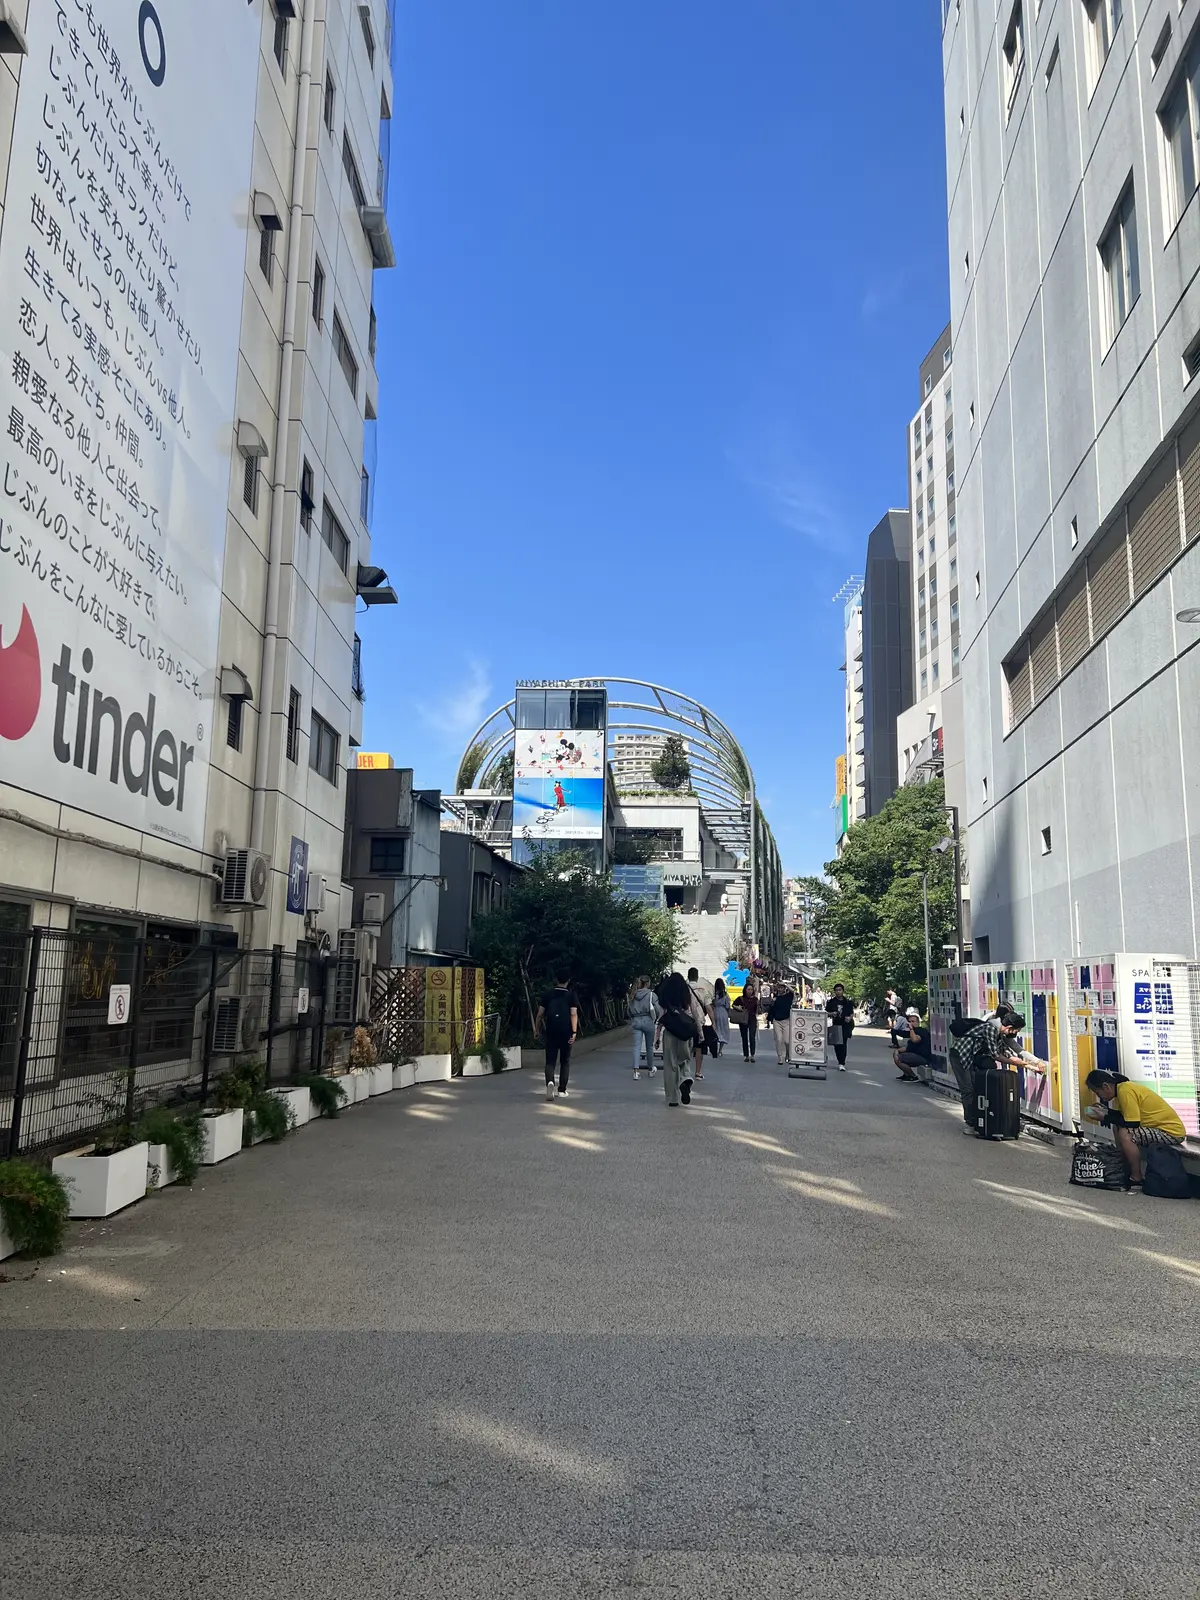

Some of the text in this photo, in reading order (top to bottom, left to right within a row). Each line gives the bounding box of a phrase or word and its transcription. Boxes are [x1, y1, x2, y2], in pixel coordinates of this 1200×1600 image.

[75, 0, 191, 222] も世界がじぶんだけで
[36, 140, 165, 357] 切なくさせるのは他人。
[18, 296, 143, 468] 恋人。友だち。仲間。
[23, 245, 167, 451] 生きてる実感そこにあり。
[6, 405, 187, 605] 最高のいまをじぶんに与えたい。
[52, 643, 194, 812] tinder
[515, 679, 606, 688] MIYASHITA PARK
[663, 874, 702, 882] MIYASHITA
[1076, 1160, 1099, 1170] Take
[1081, 1169, 1104, 1178] easy
